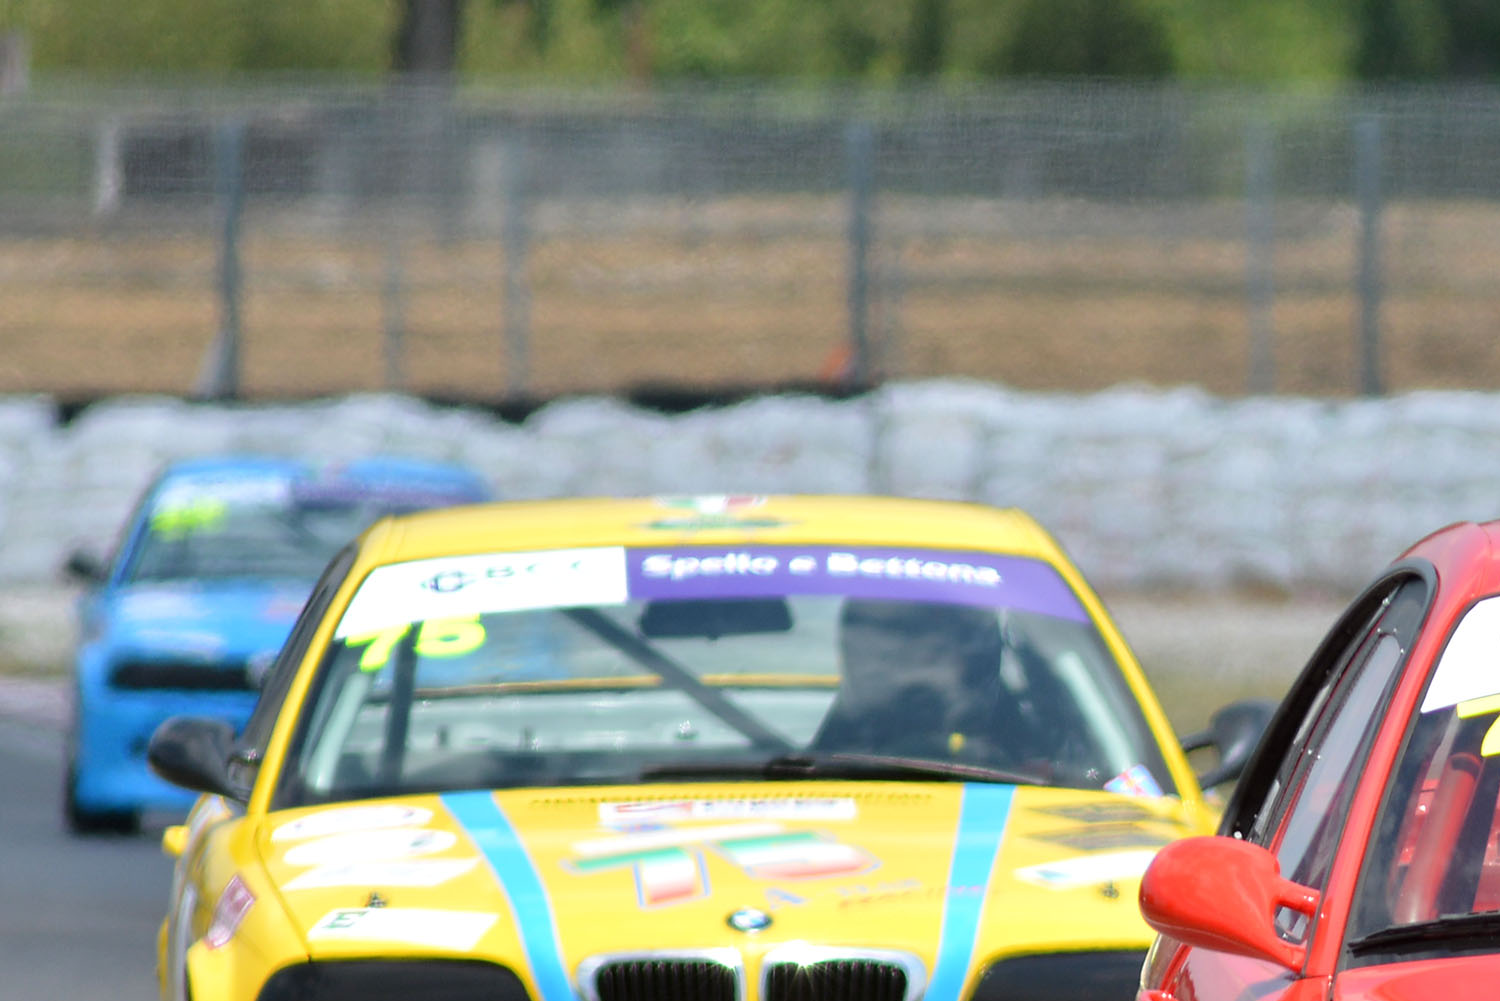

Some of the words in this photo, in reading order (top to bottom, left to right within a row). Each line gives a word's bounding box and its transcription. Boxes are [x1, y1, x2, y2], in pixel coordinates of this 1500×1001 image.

[642, 552, 780, 581] Spello
[788, 555, 817, 575] e
[827, 552, 1002, 586] Bettona
